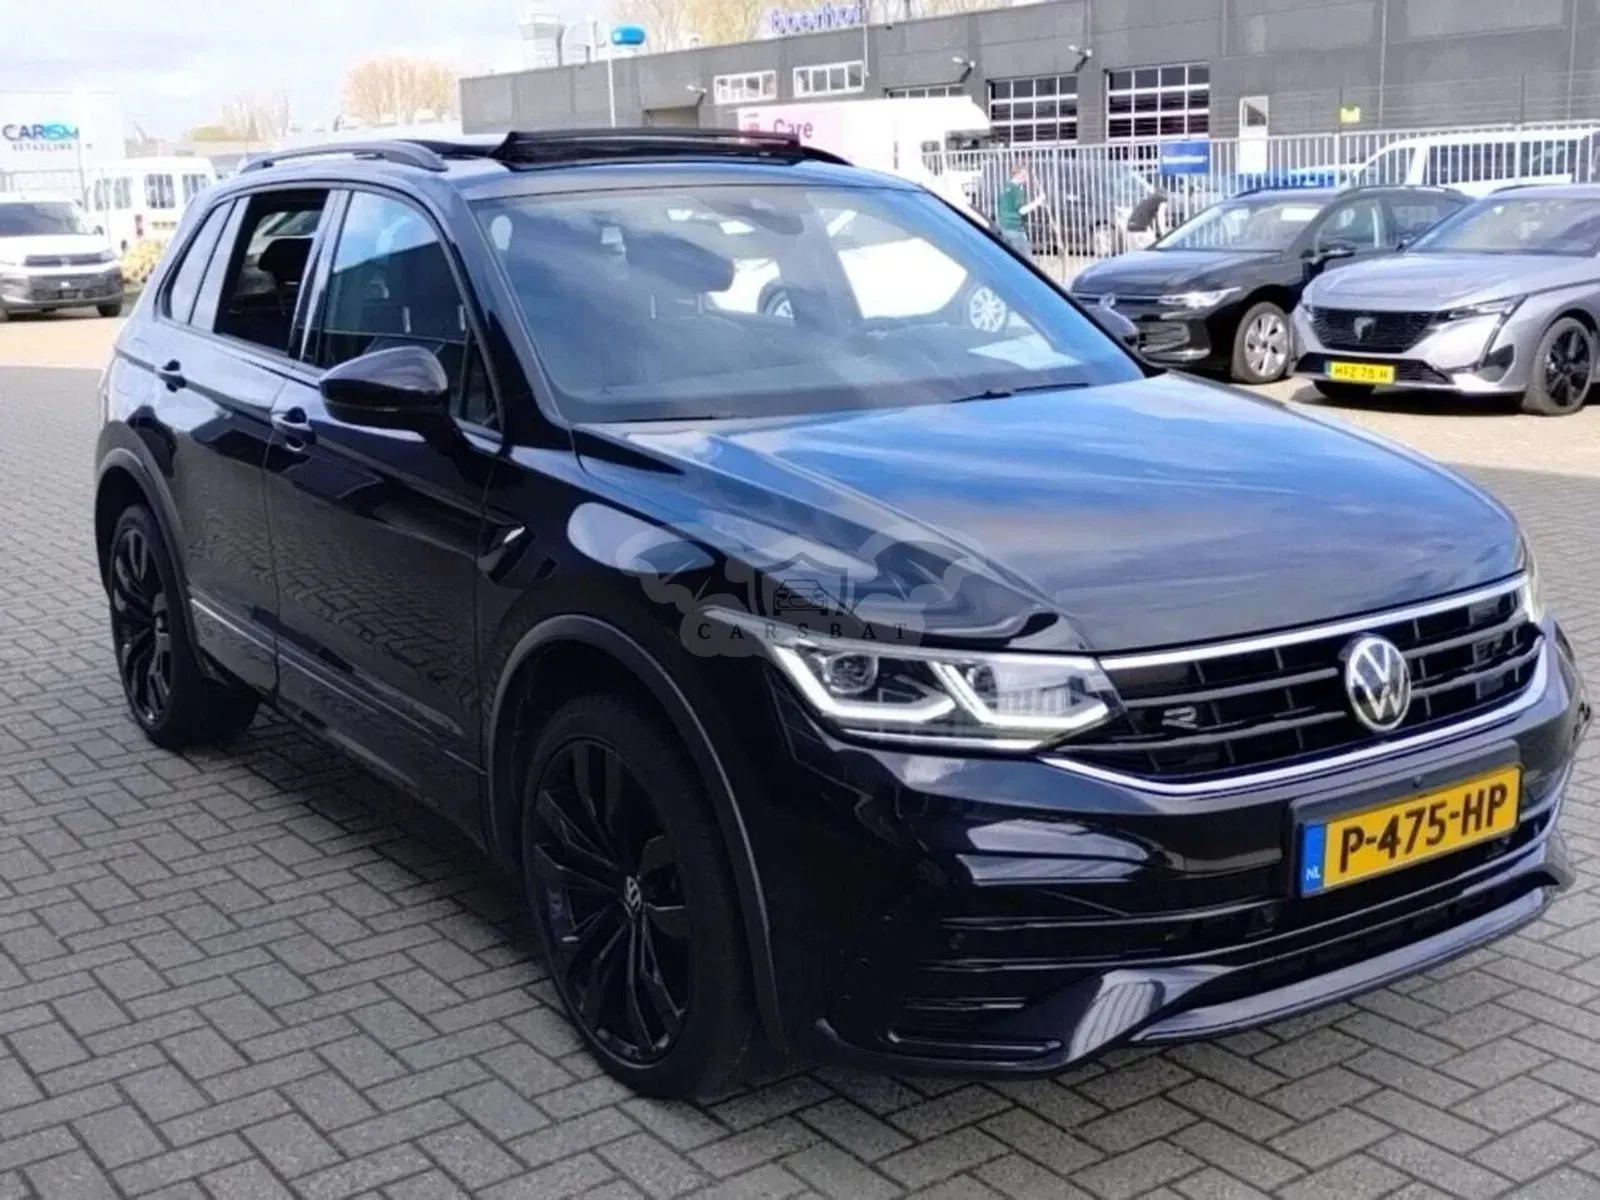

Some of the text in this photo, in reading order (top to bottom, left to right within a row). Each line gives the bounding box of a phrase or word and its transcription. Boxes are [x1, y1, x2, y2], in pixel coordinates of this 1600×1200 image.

[772, 117, 814, 139] Care
[1339, 782, 1508, 874] P-475-HP
[1305, 865, 1321, 881] NL
